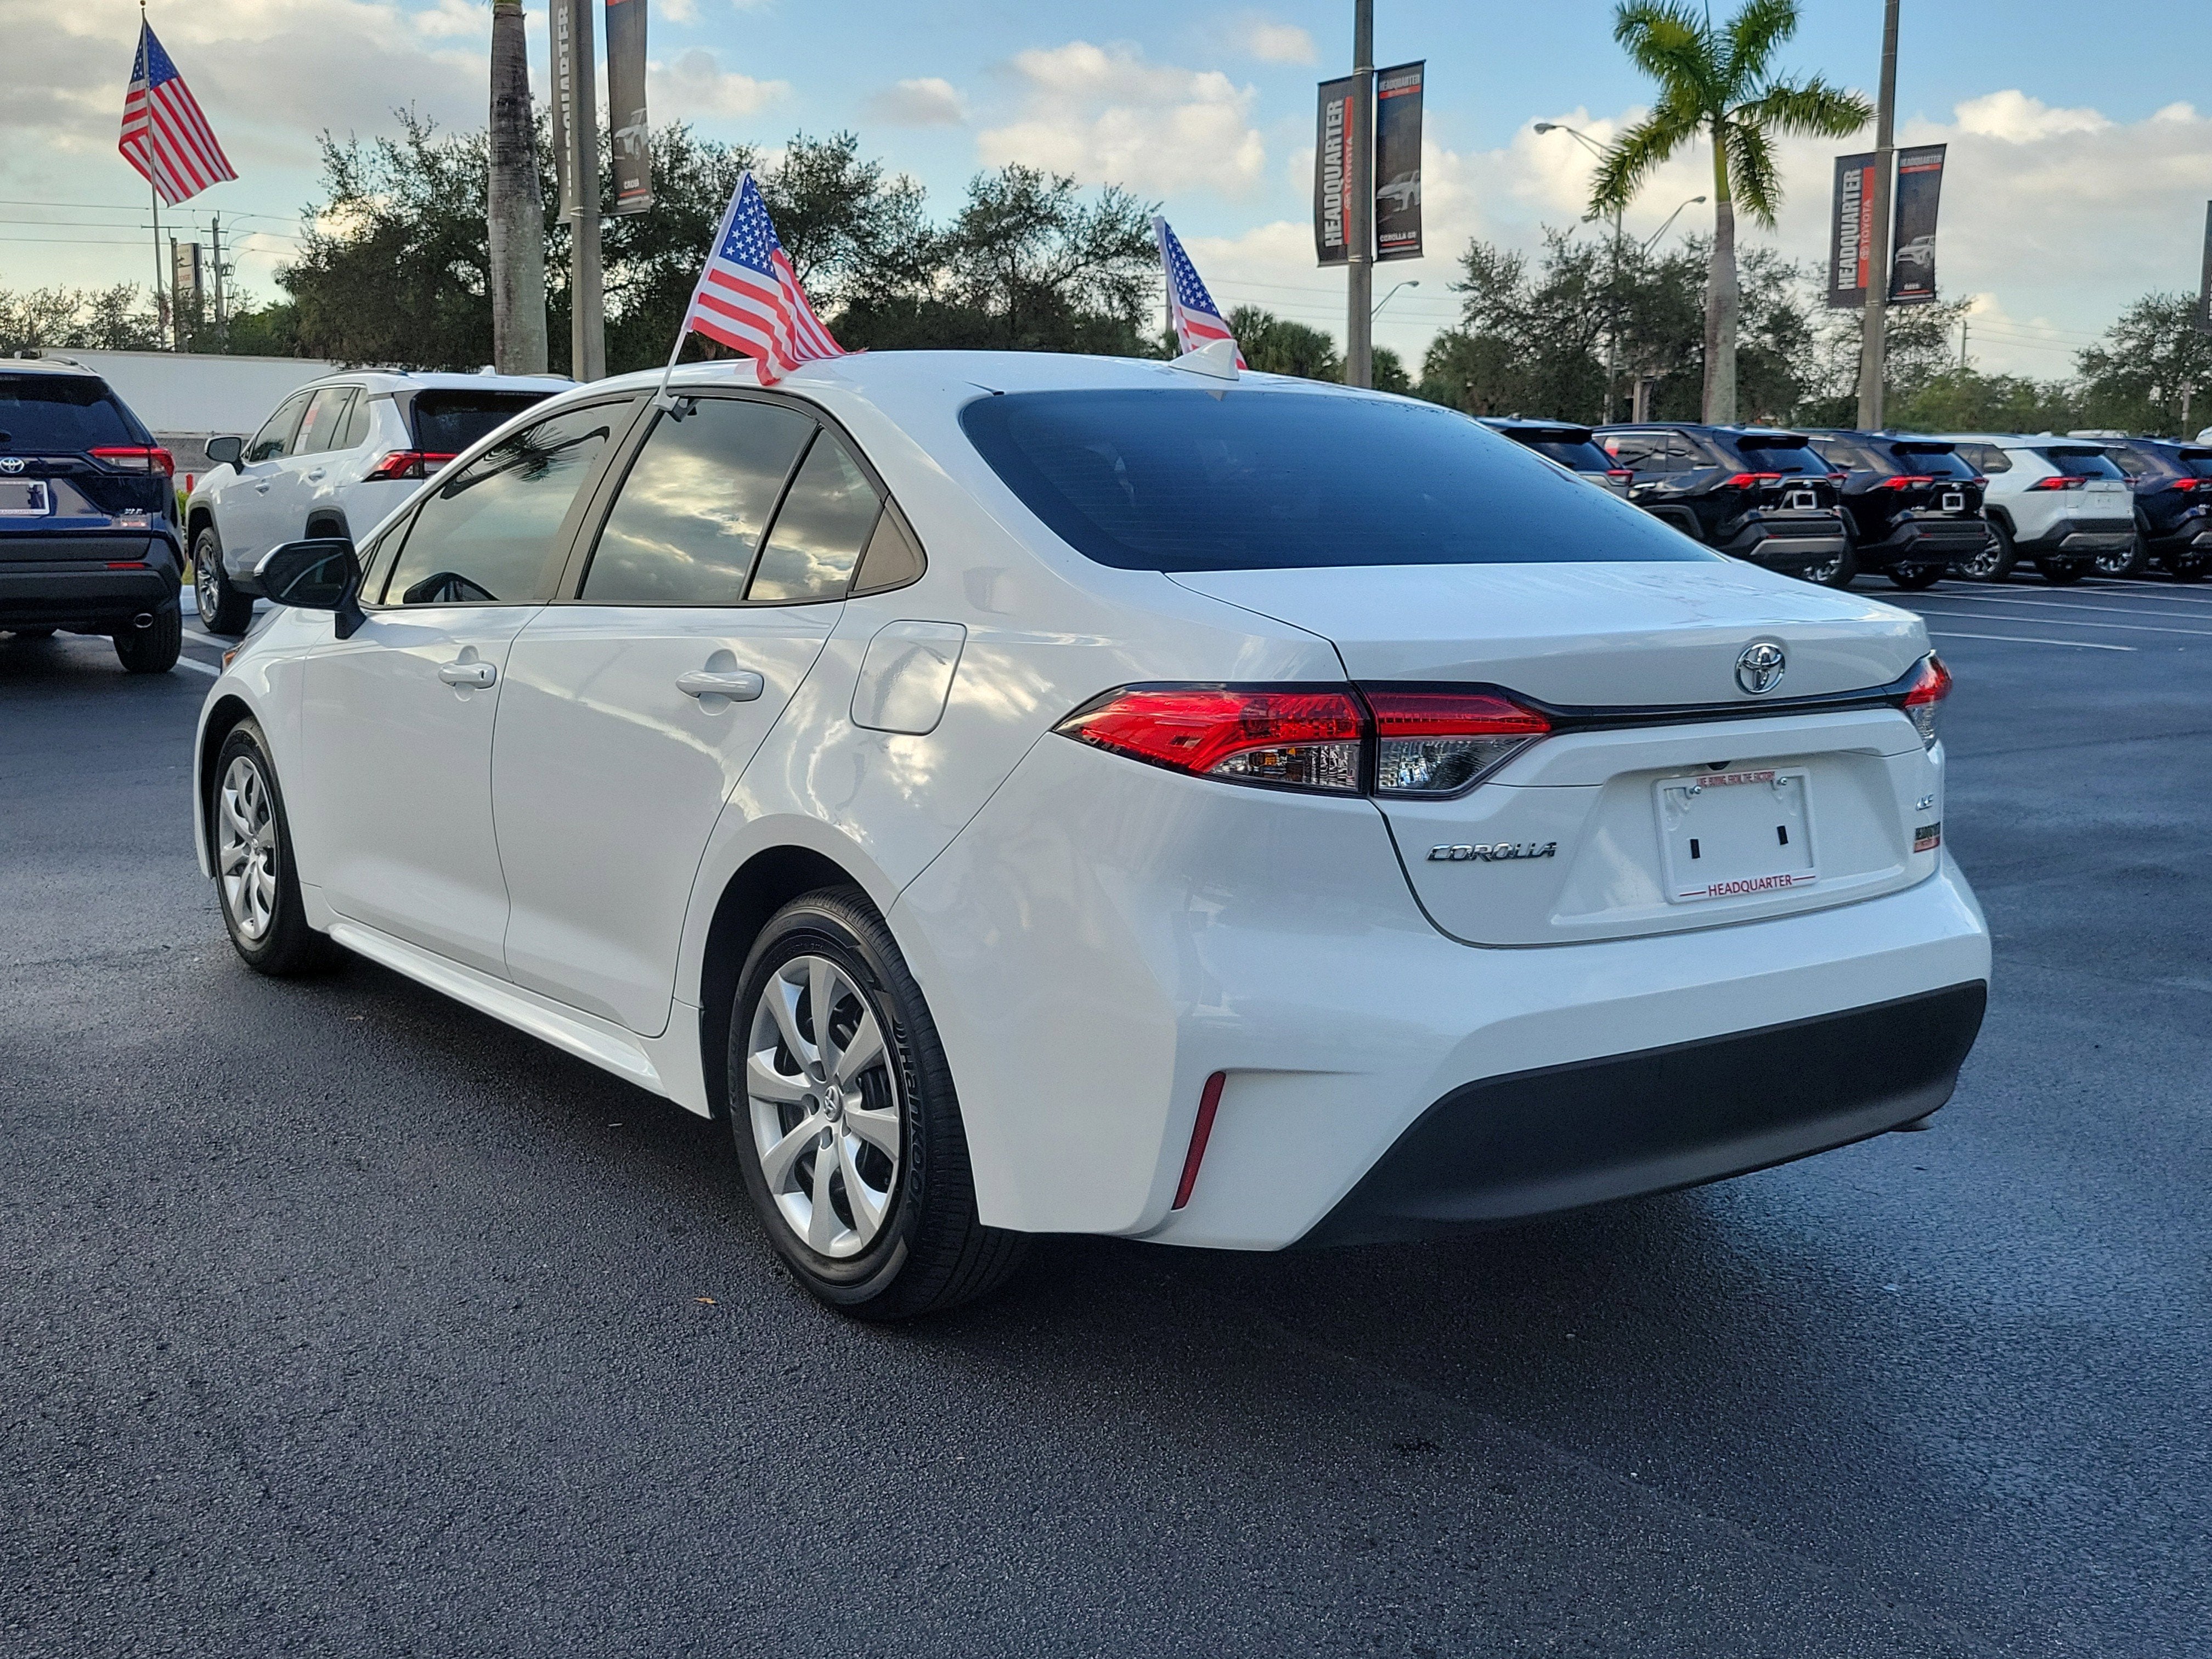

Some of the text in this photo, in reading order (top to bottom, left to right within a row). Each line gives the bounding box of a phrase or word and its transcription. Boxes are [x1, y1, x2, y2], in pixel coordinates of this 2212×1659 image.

[1324, 99, 1344, 247] HEADQUARTER
[1838, 169, 1862, 290] HEADQUARTER
[1861, 199, 1872, 244] TOYOTA
[1426, 842, 1557, 862] COROLLA
[1708, 874, 1792, 896] HEADQUARTER
